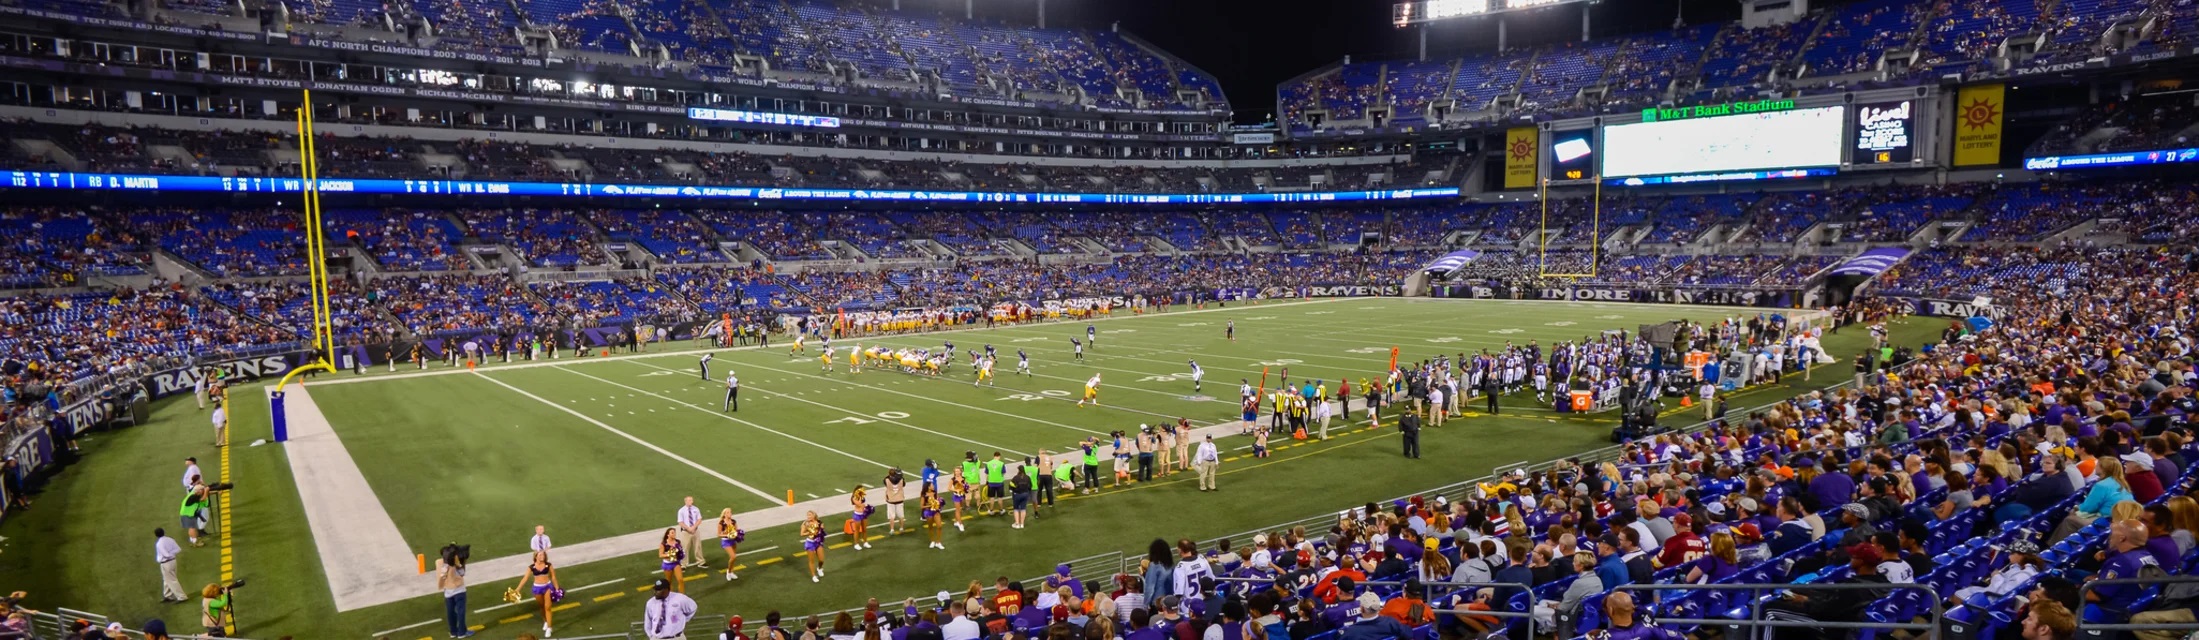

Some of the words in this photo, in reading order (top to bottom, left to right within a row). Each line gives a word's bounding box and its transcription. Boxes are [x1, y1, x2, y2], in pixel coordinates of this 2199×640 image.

[155, 25, 193, 34] LOCATION
[308, 39, 329, 48] AFC
[332, 41, 369, 51] NORTH
[372, 44, 430, 57] CHAMPIONS
[433, 50, 456, 59] 2003
[465, 53, 487, 61] 2006
[496, 56, 514, 64] 2011
[522, 58, 541, 66] 2012
[2015, 61, 2085, 75] RAVENS
[221, 76, 254, 85] MATT
[257, 79, 301, 88] STOVER
[313, 82, 368, 92] JONATHAN
[371, 86, 405, 94] OGDEN
[738, 78, 763, 86] WORLD
[776, 82, 816, 91] CHAMPIONS
[416, 89, 459, 98] MICHAEL
[974, 98, 1005, 106] CHAMPIONS
[1660, 107, 1690, 120] M&T
[1695, 102, 1730, 116] Bank
[1733, 98, 1794, 113] Stadium
[2166, 151, 2176, 162] 27
[12, 177, 27, 187] 112
[89, 176, 103, 187] RB
[110, 176, 121, 188] D.
[124, 177, 158, 189] MARTIN
[284, 180, 299, 191] WR
[319, 181, 354, 191] JACKSON
[458, 183, 472, 193] WR
[1312, 285, 1399, 297] RAVENS
[1576, 397, 1586, 407] G
